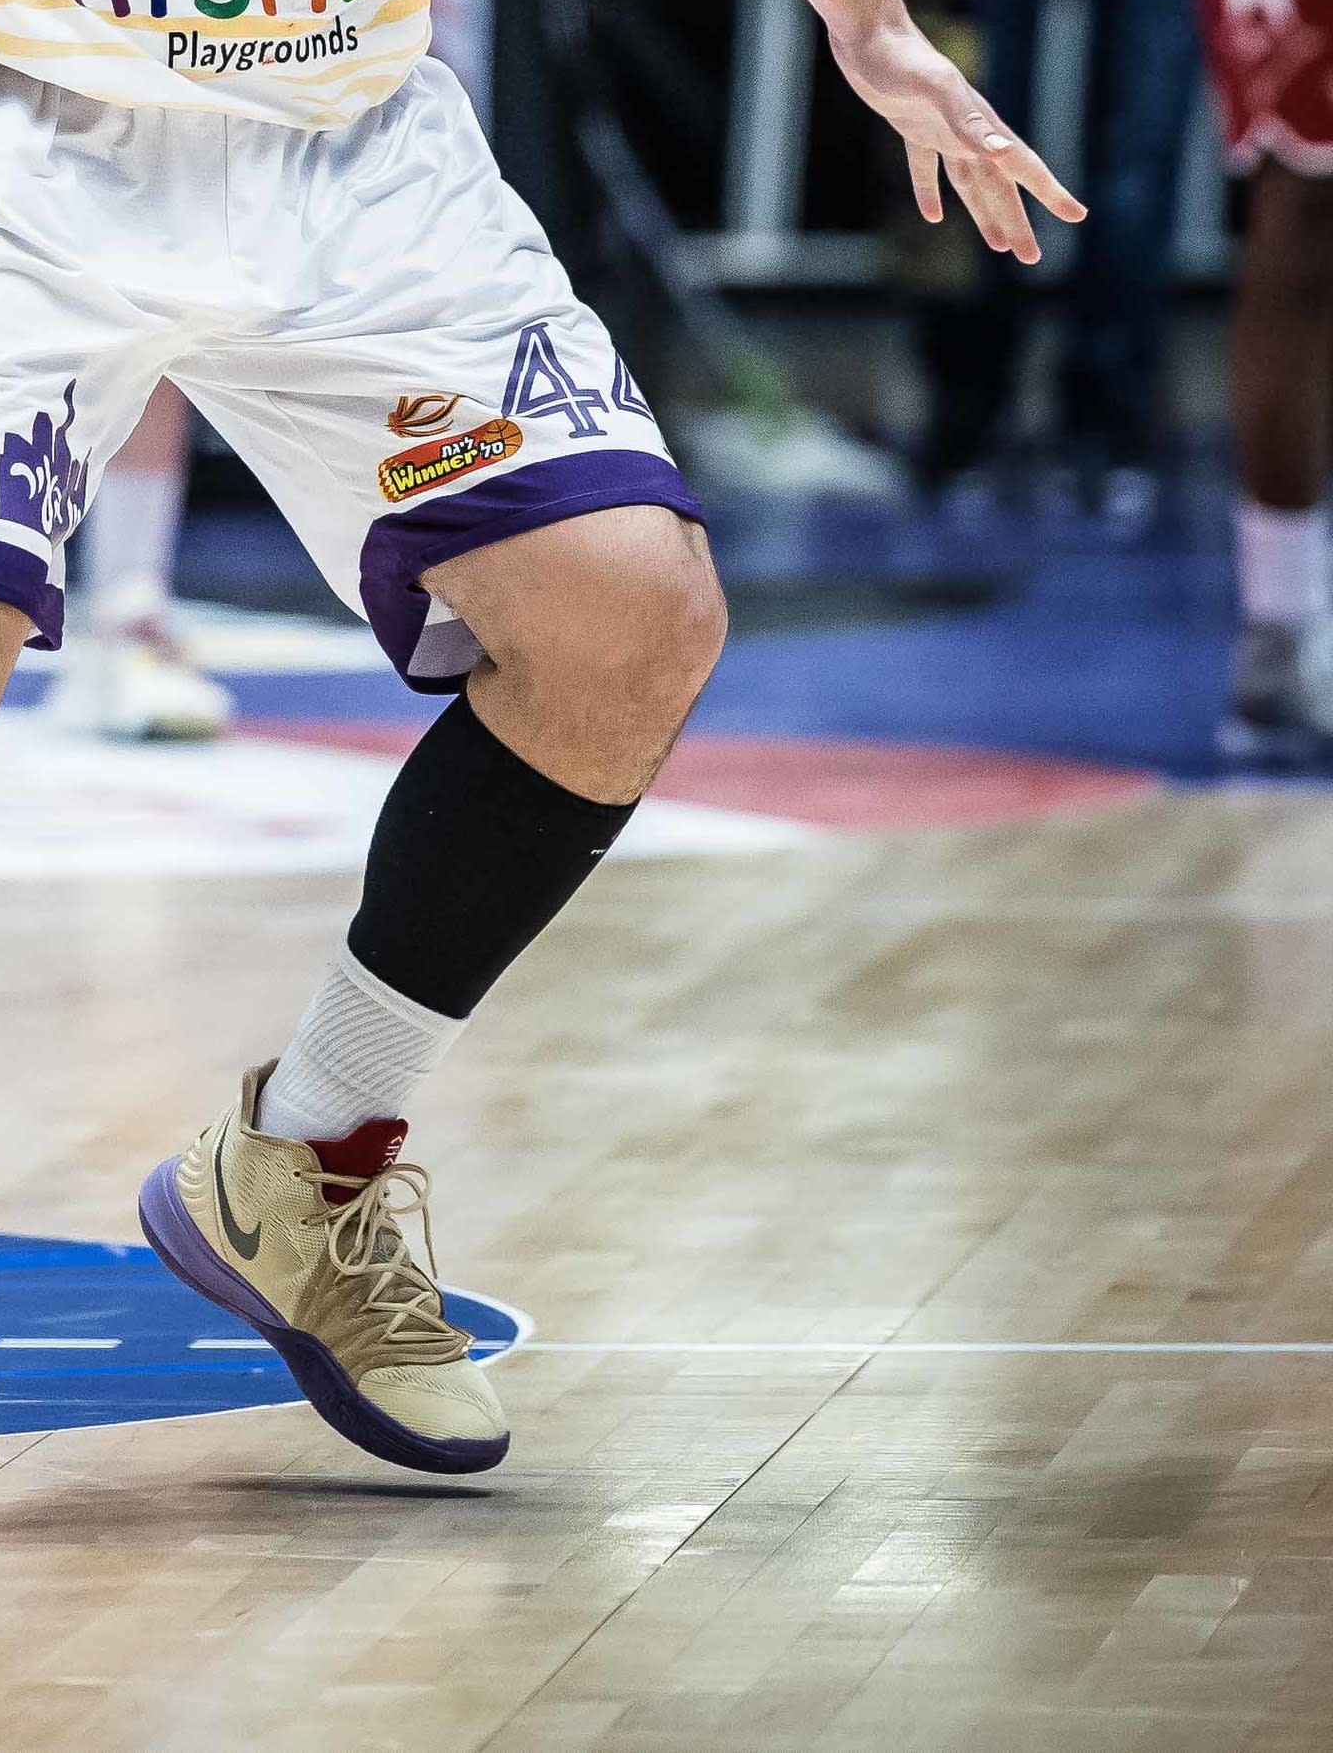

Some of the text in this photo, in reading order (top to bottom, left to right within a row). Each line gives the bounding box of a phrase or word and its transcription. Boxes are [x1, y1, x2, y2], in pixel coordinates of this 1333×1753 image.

[167, 15, 359, 74] Playgrounds
[441, 435, 475, 459] ליגת
[391, 449, 478, 492] Winner
